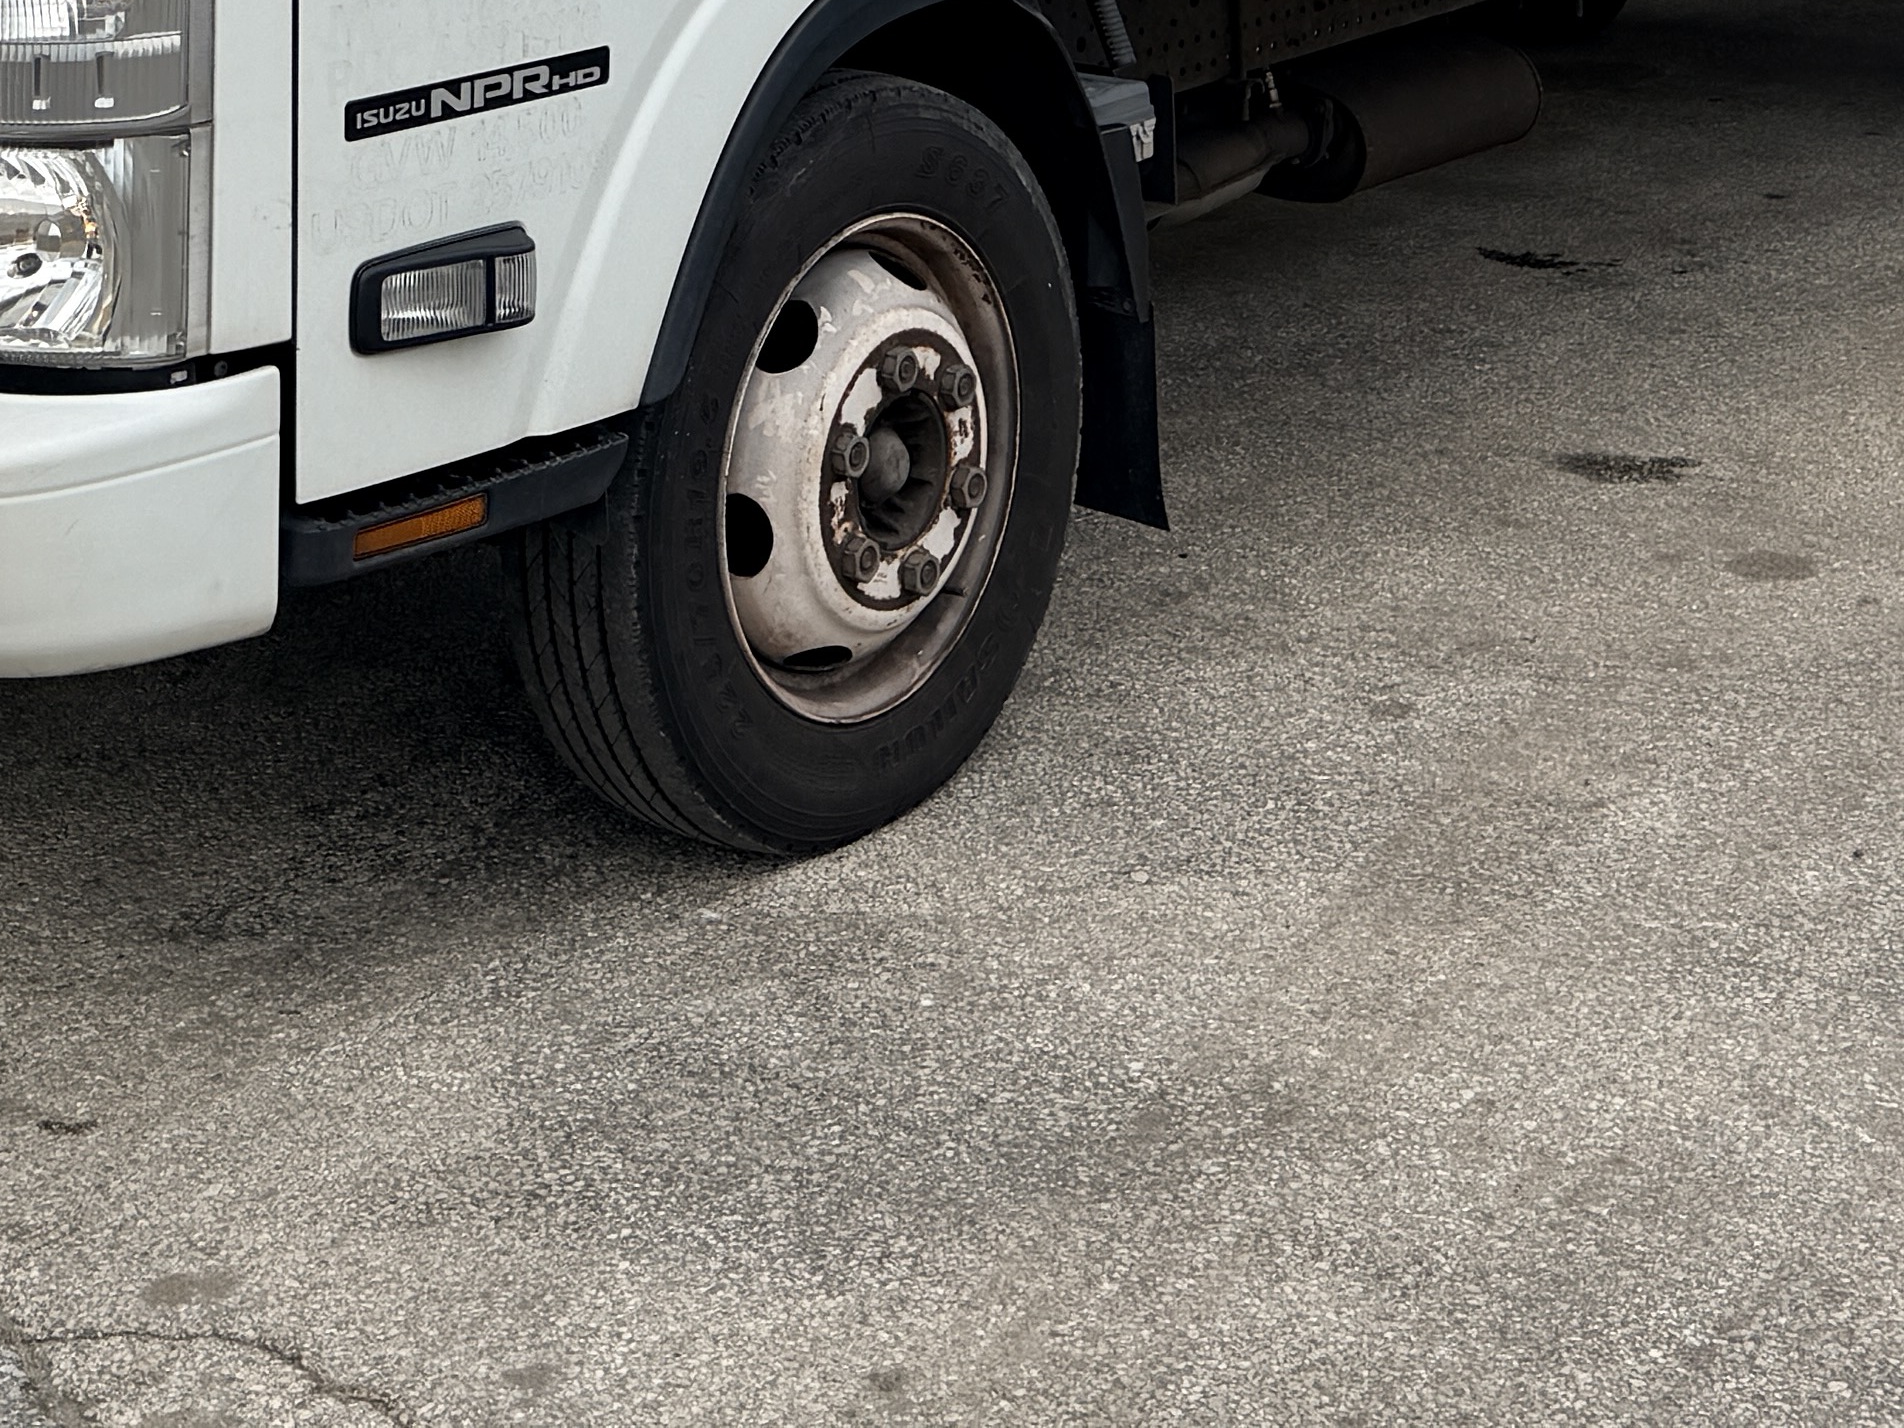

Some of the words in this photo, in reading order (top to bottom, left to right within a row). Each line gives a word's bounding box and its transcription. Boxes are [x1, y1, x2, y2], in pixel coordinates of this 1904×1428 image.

[356, 99, 425, 130] ISUZU
[430, 65, 550, 118] NPR
[551, 66, 601, 91] HD
